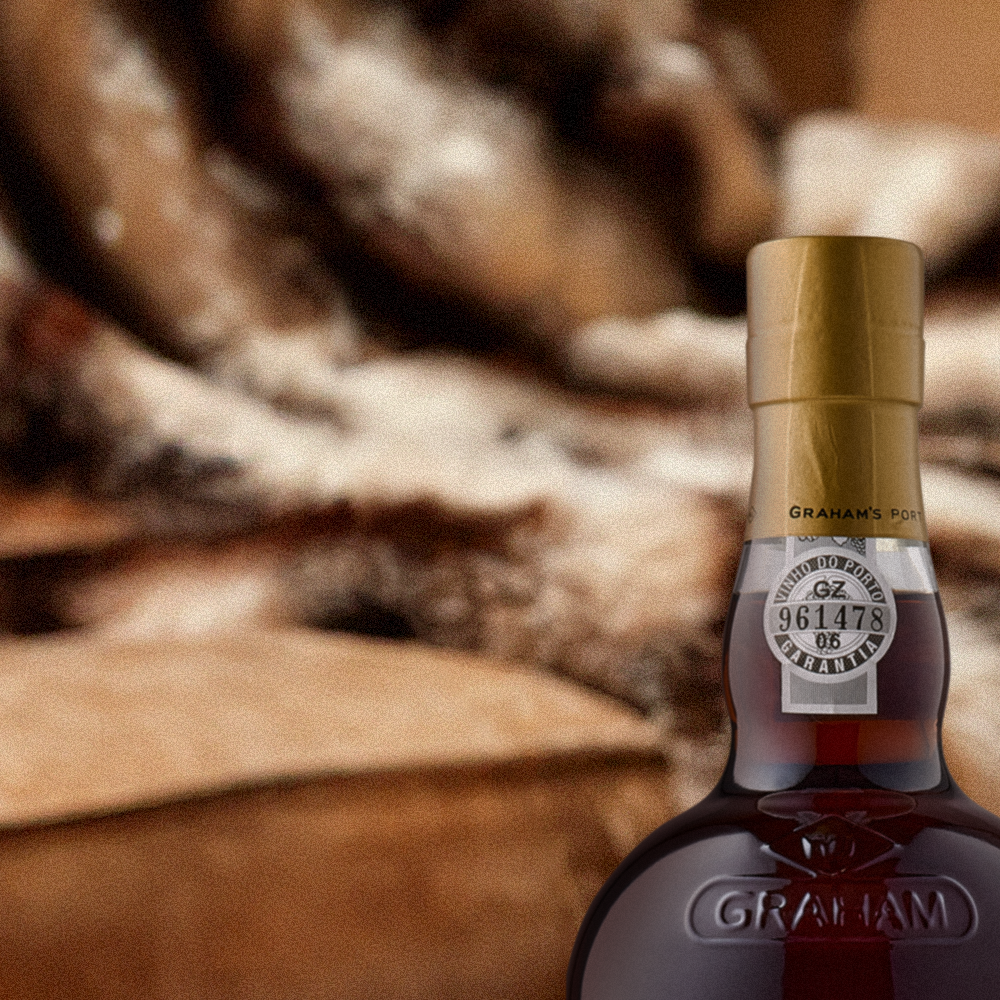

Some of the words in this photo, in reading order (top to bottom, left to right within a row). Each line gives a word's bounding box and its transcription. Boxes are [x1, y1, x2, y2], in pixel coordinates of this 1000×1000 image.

[789, 505, 882, 520] GRAHAM'S
[774, 561, 811, 602] VINHO
[817, 556, 838, 569] DO
[843, 559, 884, 601] PORTO
[813, 580, 846, 599] GZ
[778, 604, 884, 633] 961478
[780, 640, 879, 674] GARANTIA
[714, 890, 949, 931] GRAHAM
